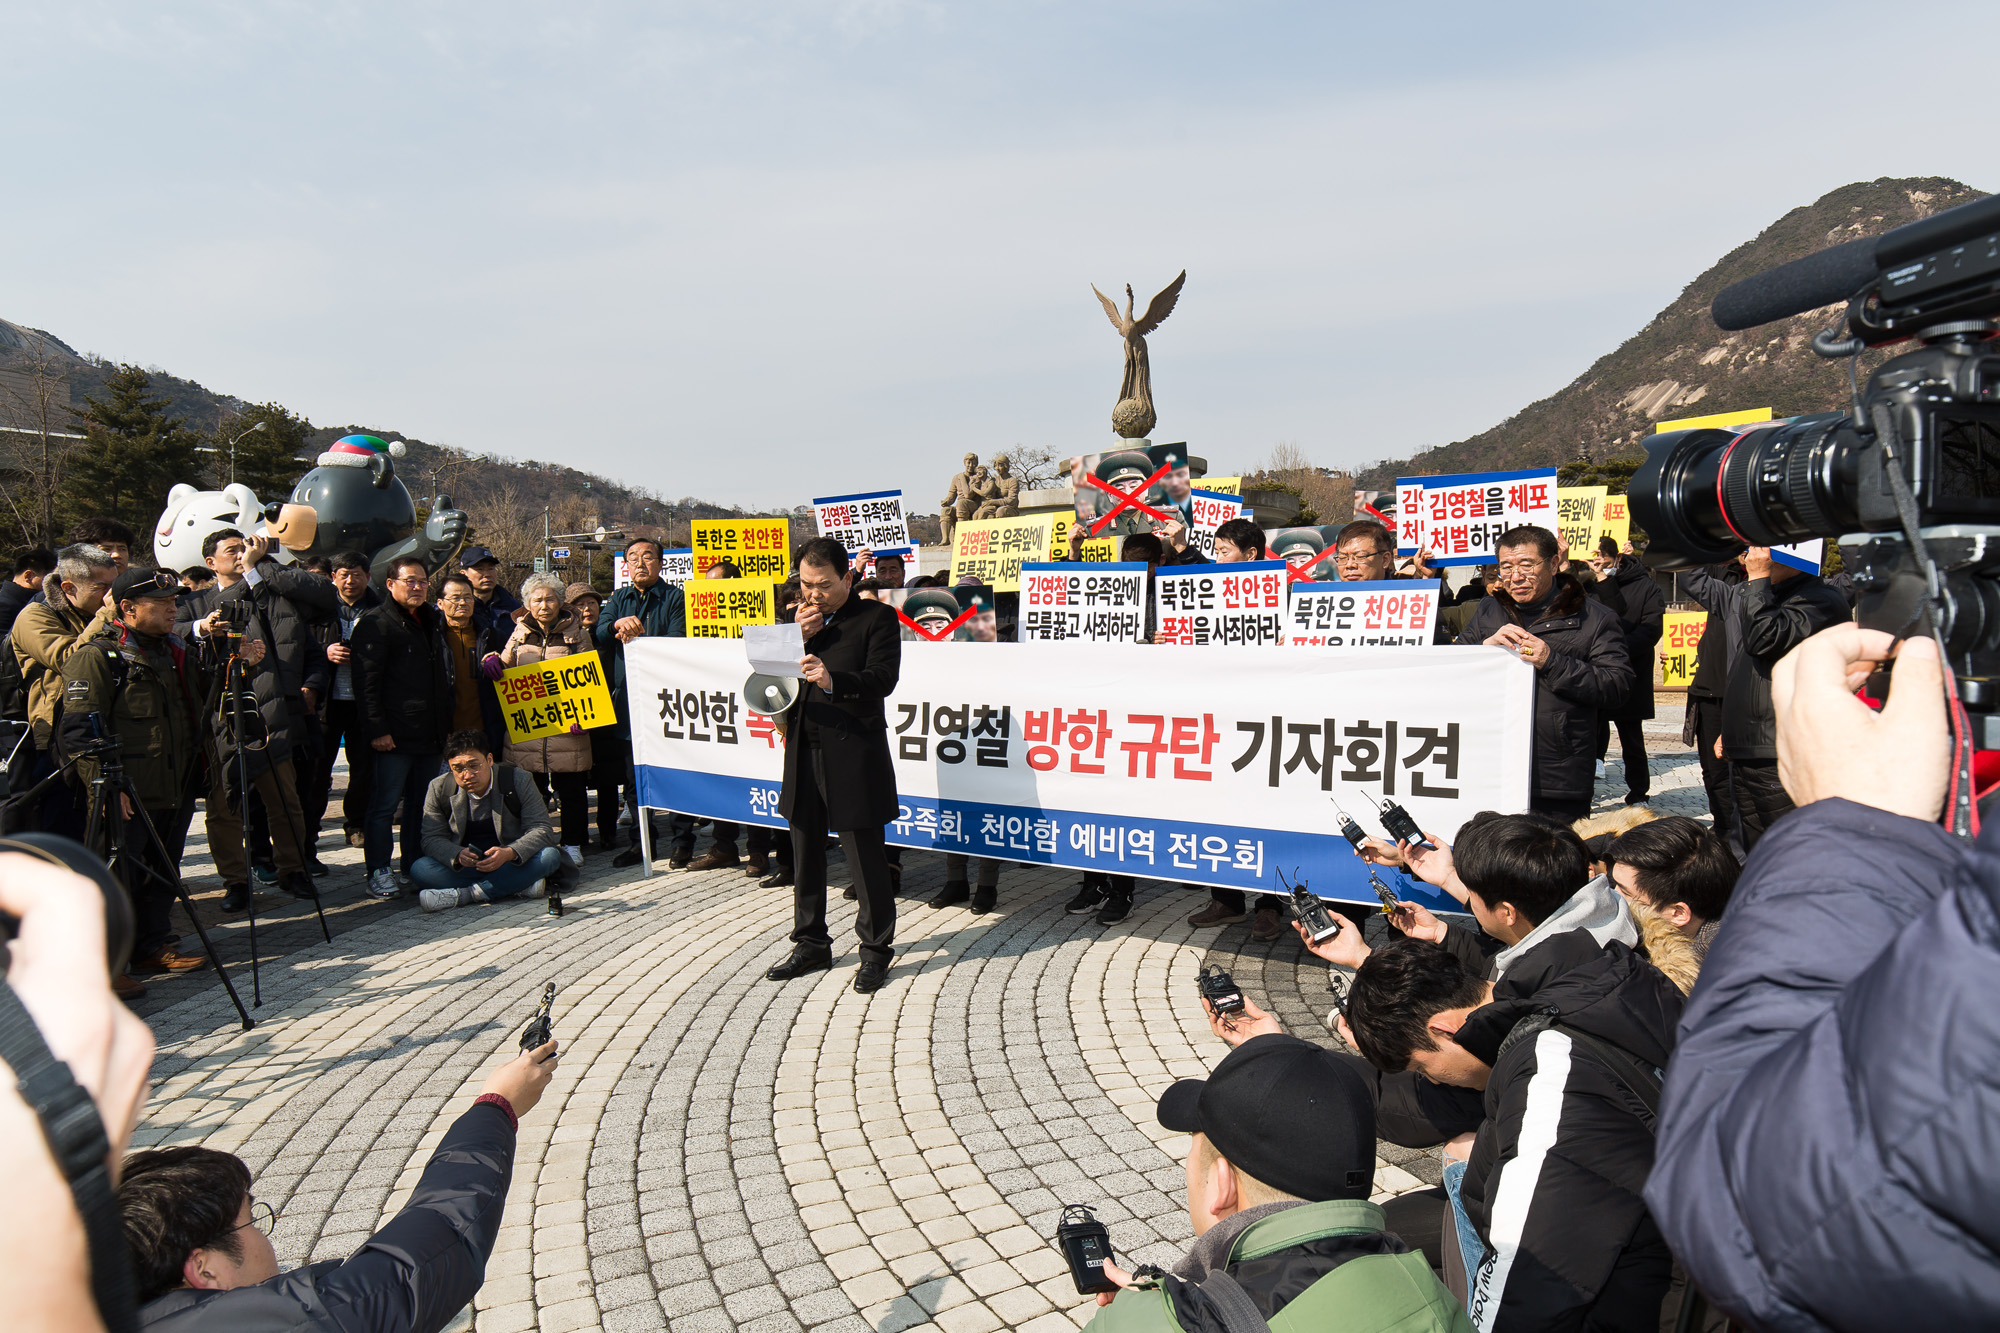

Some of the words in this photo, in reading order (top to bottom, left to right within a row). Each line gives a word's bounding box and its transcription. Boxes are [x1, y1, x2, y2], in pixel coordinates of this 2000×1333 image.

[821, 503, 860, 527] 김영철은
[861, 499, 902, 523] 유족앞에
[1193, 500, 1236, 527] 천안함
[1430, 487, 1505, 520] 김영철을
[1508, 484, 1550, 514] 체포
[1557, 497, 1596, 521] 족앞에
[696, 529, 737, 550] 북한은
[742, 527, 784, 550] 천안함
[867, 524, 906, 547] 사죄하라
[960, 529, 999, 556] 김영철은
[1001, 525, 1044, 551] 유족앞에
[737, 554, 785, 576] 사죄하라
[691, 592, 726, 620] 김영철은
[729, 590, 767, 619] 유족앞에
[1028, 576, 1081, 605] 김영철은
[1084, 576, 1140, 606] 유족앞에
[1161, 578, 1216, 611] 북한은
[1222, 574, 1281, 608] 천안함
[1026, 611, 1080, 640] 무릎꿇고
[1083, 611, 1139, 643] 사죄하라
[1294, 596, 1356, 630] 북한은
[1363, 594, 1431, 630] 천안함
[1162, 615, 1210, 645] 폭침을
[1212, 613, 1281, 646] 사죄하라
[500, 670, 560, 704] 김영철을
[560, 661, 601, 690] ICC에
[657, 688, 738, 745] 천안함
[895, 702, 1011, 768] 김영철
[1024, 708, 1112, 774] 방한
[1120, 713, 1220, 781] 규탄
[1231, 716, 1460, 799] 기자회견
[980, 813, 1060, 854] 천안함
[1069, 823, 1155, 866] 예비역
[1167, 833, 1264, 878] 전우회
